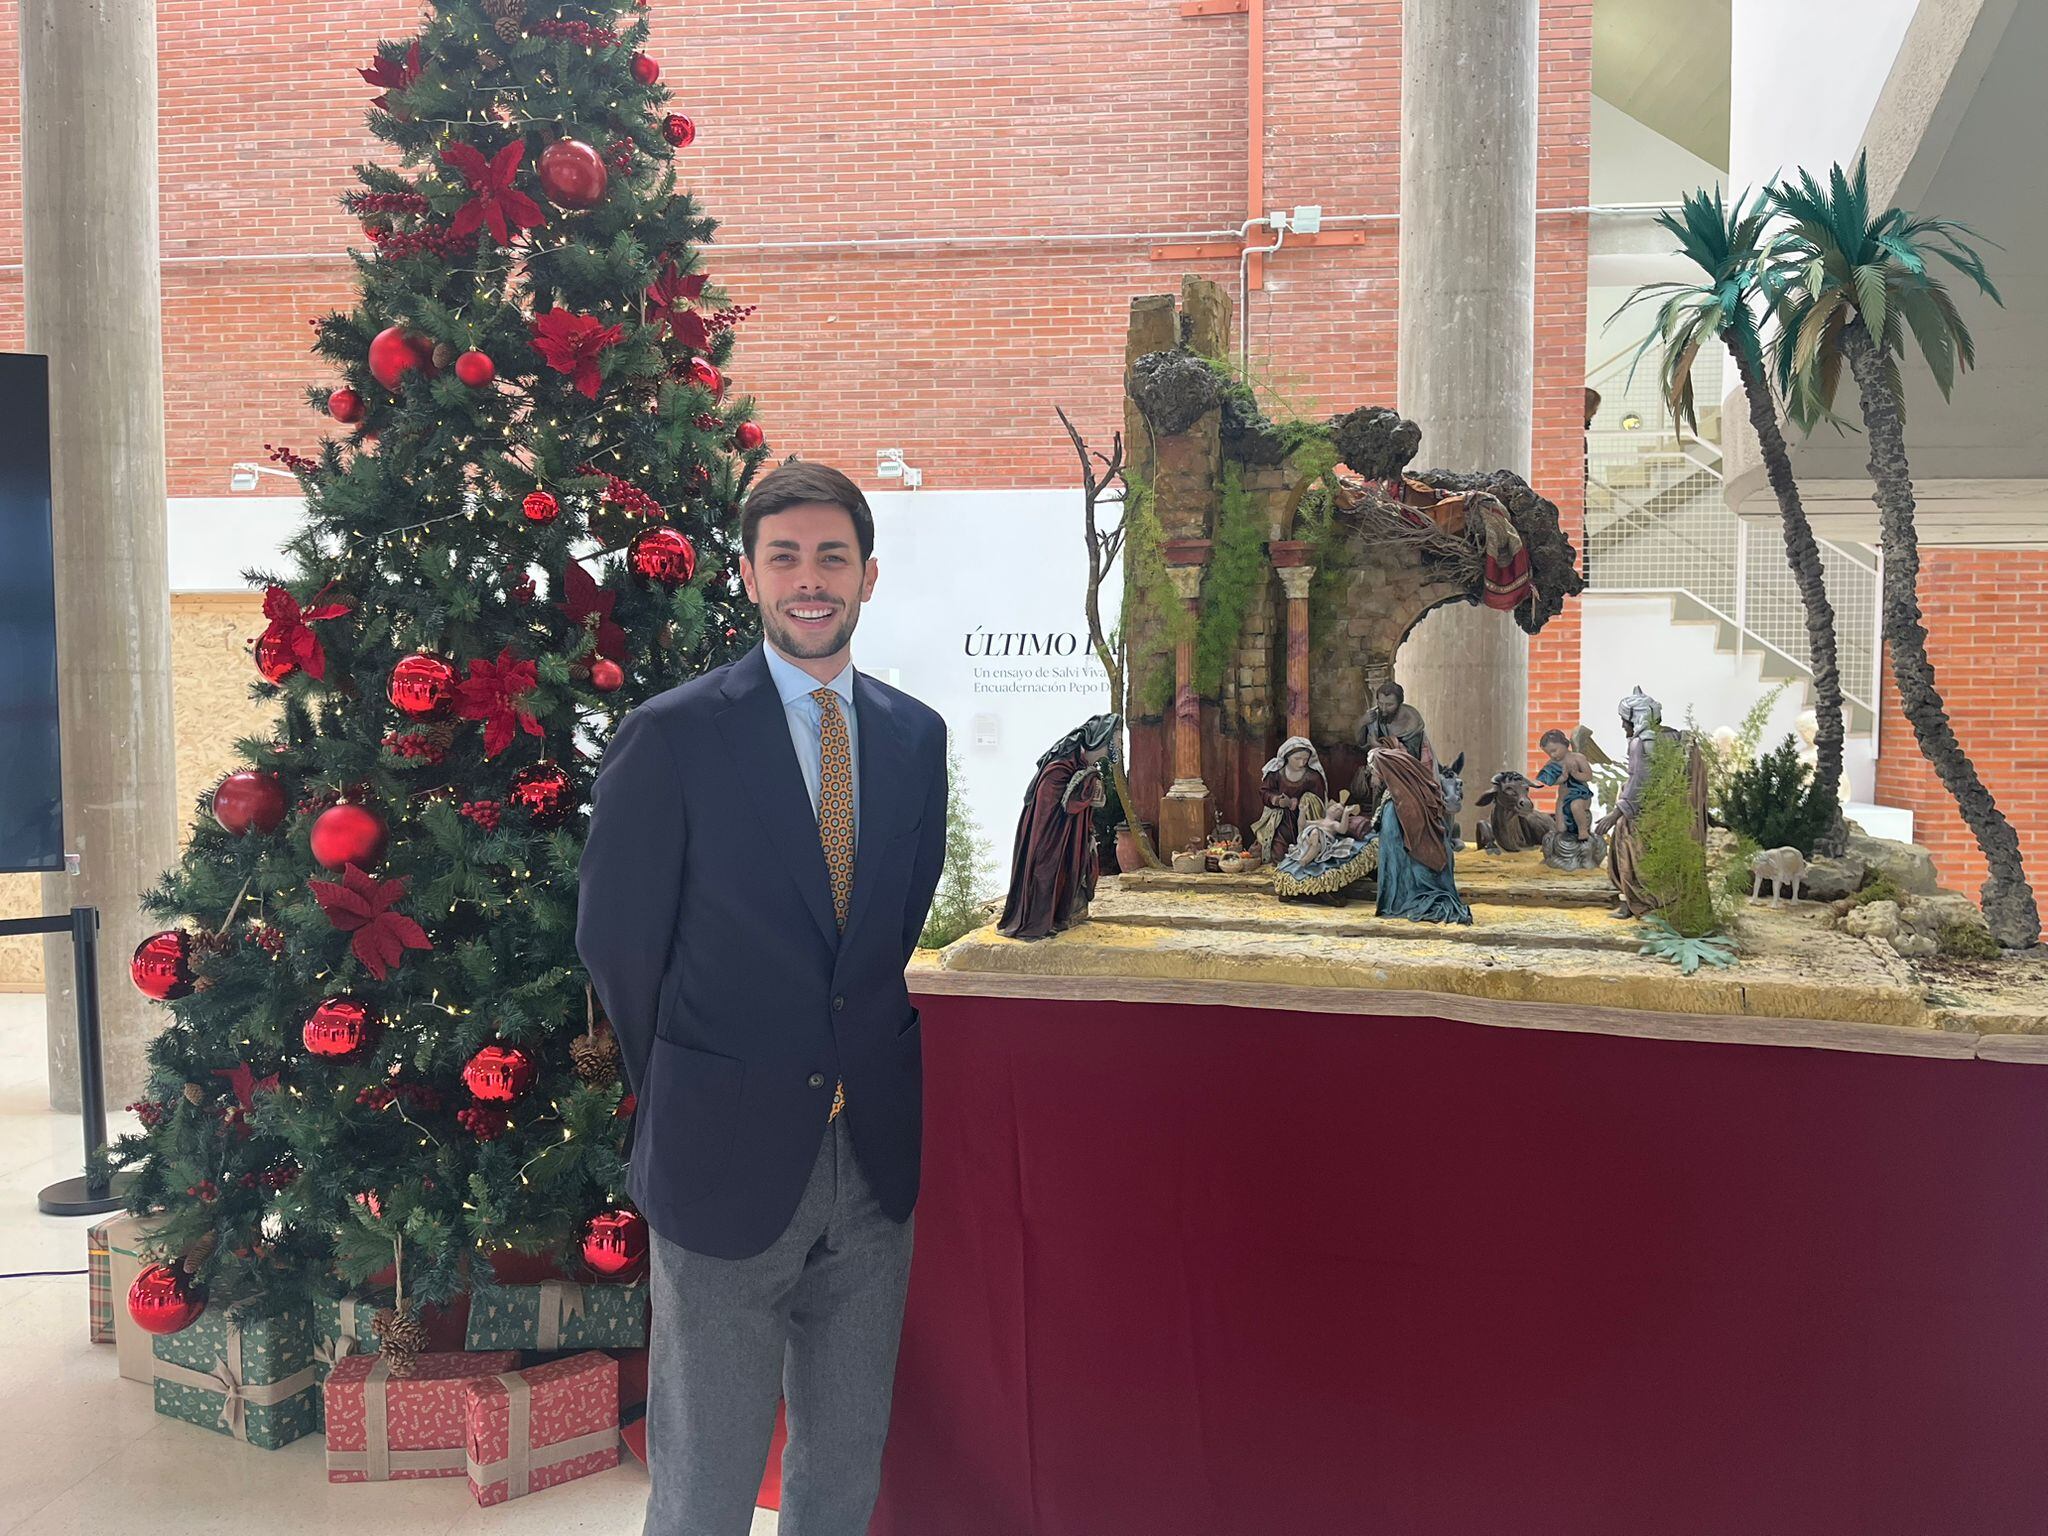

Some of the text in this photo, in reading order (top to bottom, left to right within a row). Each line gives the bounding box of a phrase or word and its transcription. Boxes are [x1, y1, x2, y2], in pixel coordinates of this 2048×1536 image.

[964, 625, 1077, 656] ÚLTIMO
[974, 667, 1107, 680] Un ensayo de Salvi Viva
[974, 682, 1066, 693] Encuadernación
[1069, 682, 1098, 695] Pepo
